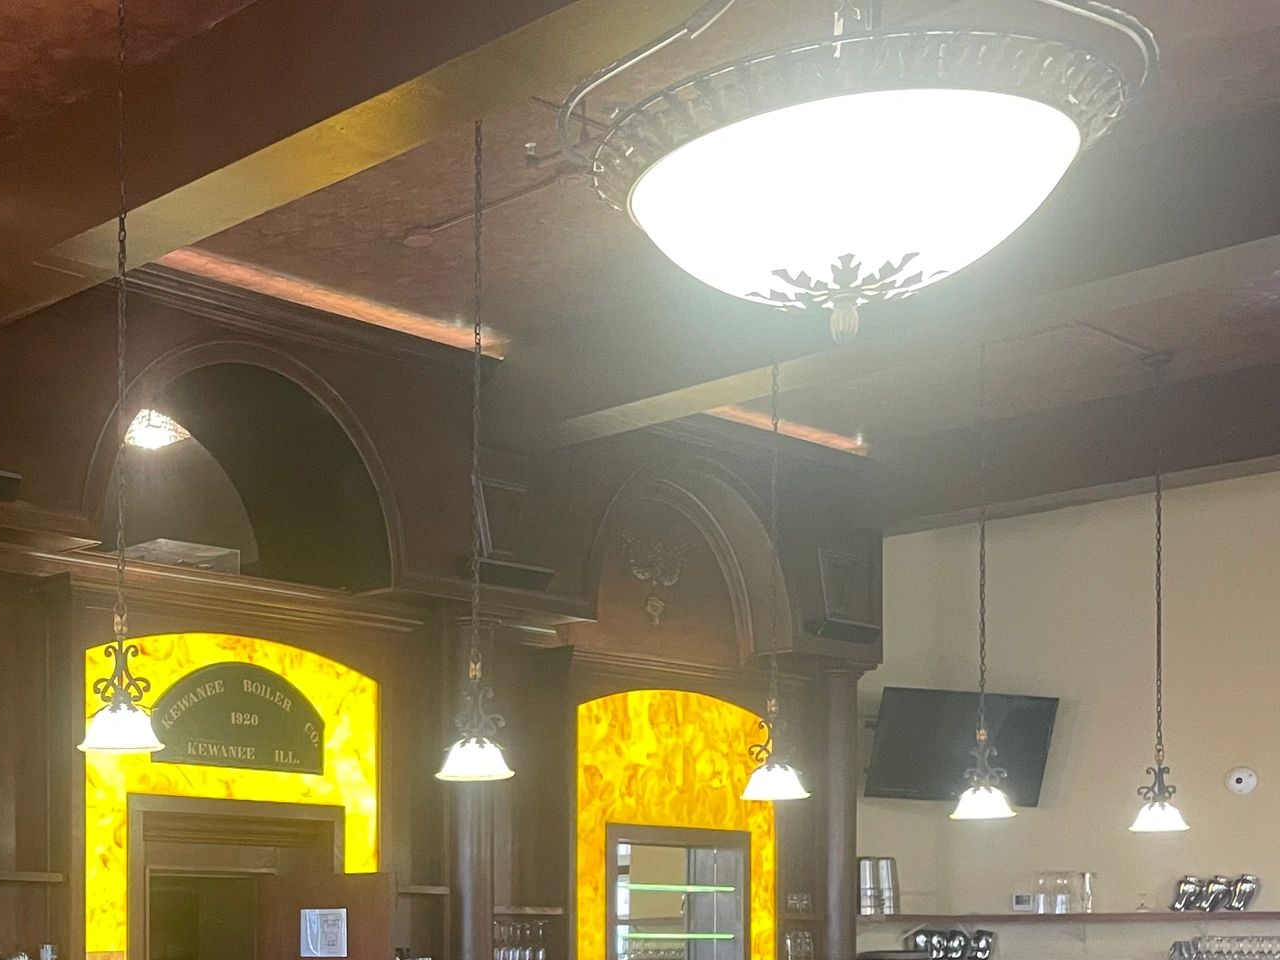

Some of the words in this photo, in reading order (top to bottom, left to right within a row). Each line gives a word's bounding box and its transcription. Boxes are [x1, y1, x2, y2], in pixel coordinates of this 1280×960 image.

[161, 680, 225, 730] KEWANEE
[243, 679, 293, 713] BOILER
[230, 711, 259, 726] 1920
[187, 742, 256, 760] KEWANEE
